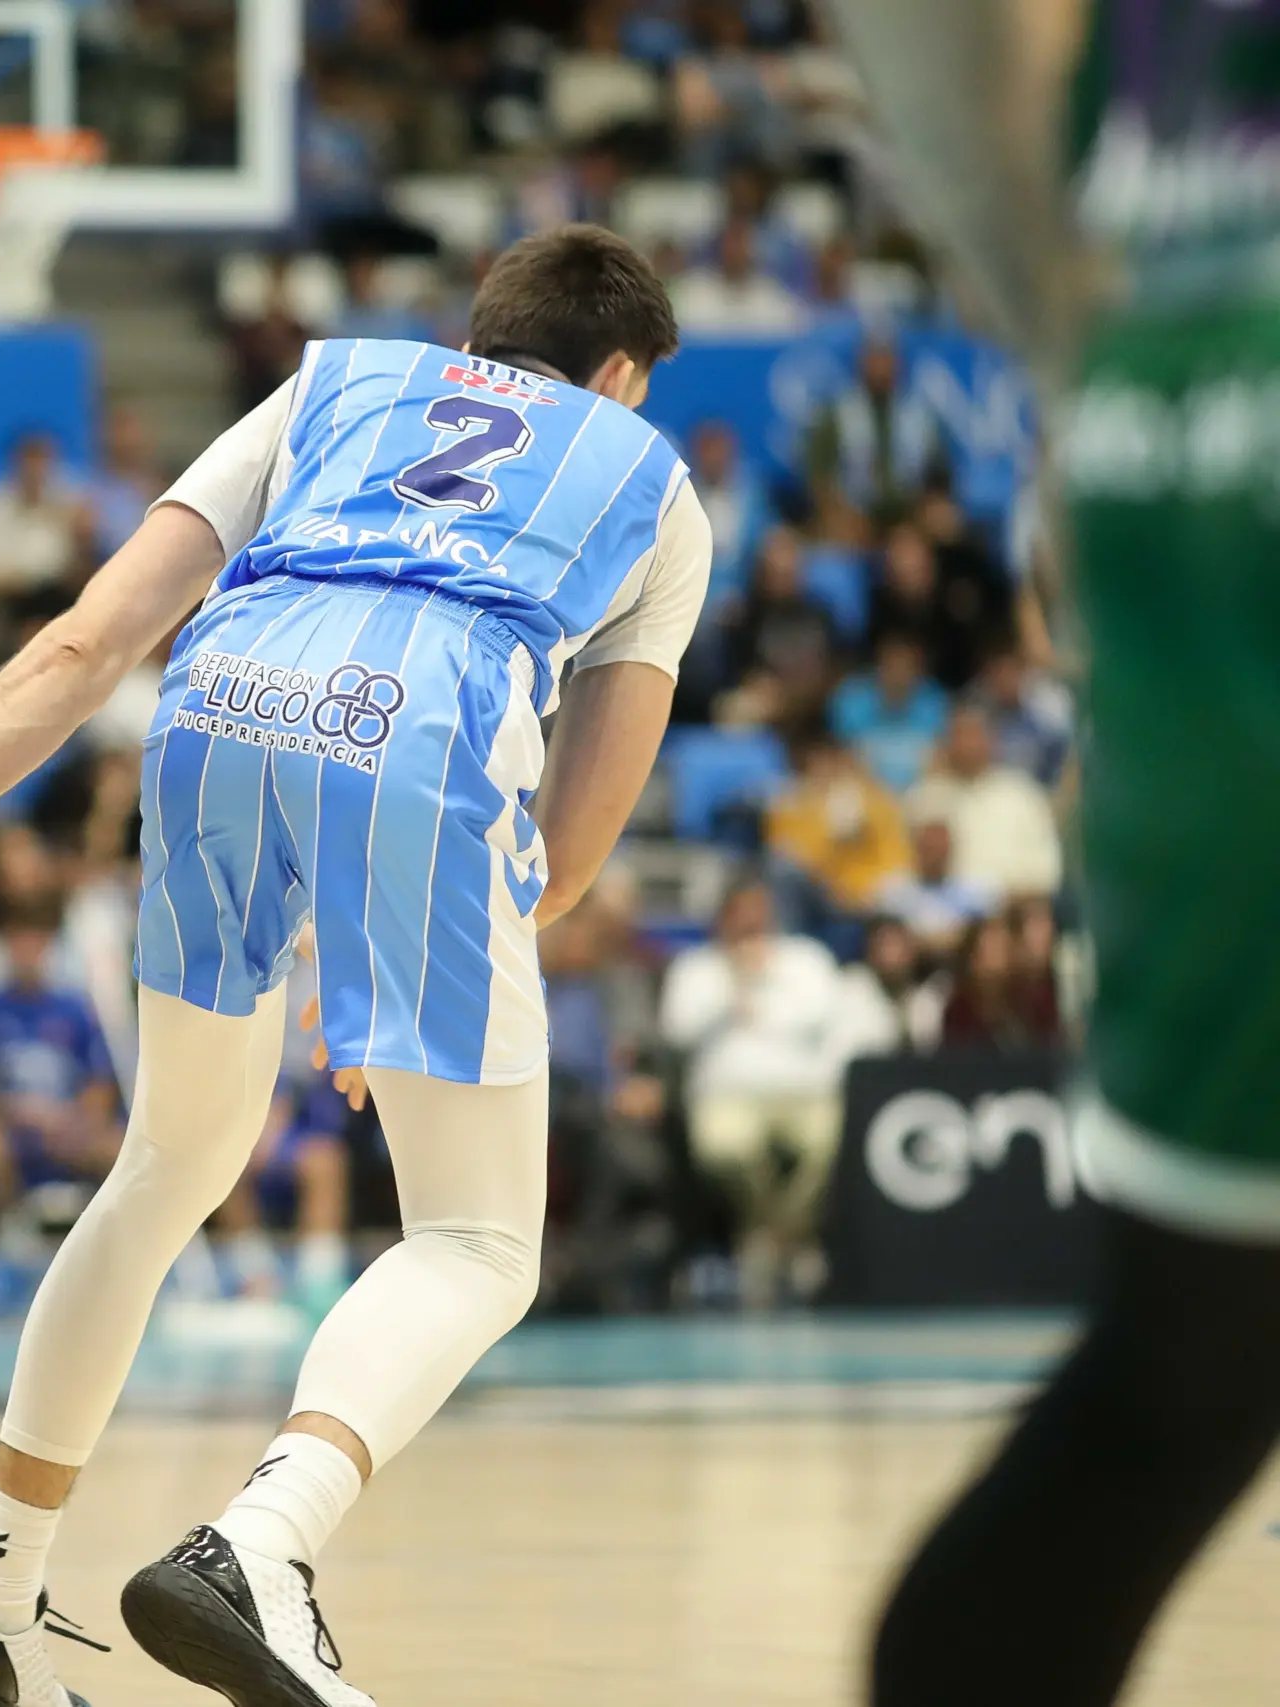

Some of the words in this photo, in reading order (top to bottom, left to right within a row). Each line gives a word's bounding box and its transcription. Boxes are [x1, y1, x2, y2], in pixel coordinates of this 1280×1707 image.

[391, 394, 533, 513] 2
[194, 653, 319, 692] DEPUTACIÓN
[207, 673, 309, 724] LUGO
[176, 709, 374, 771] VICEPRESIDENCIA
